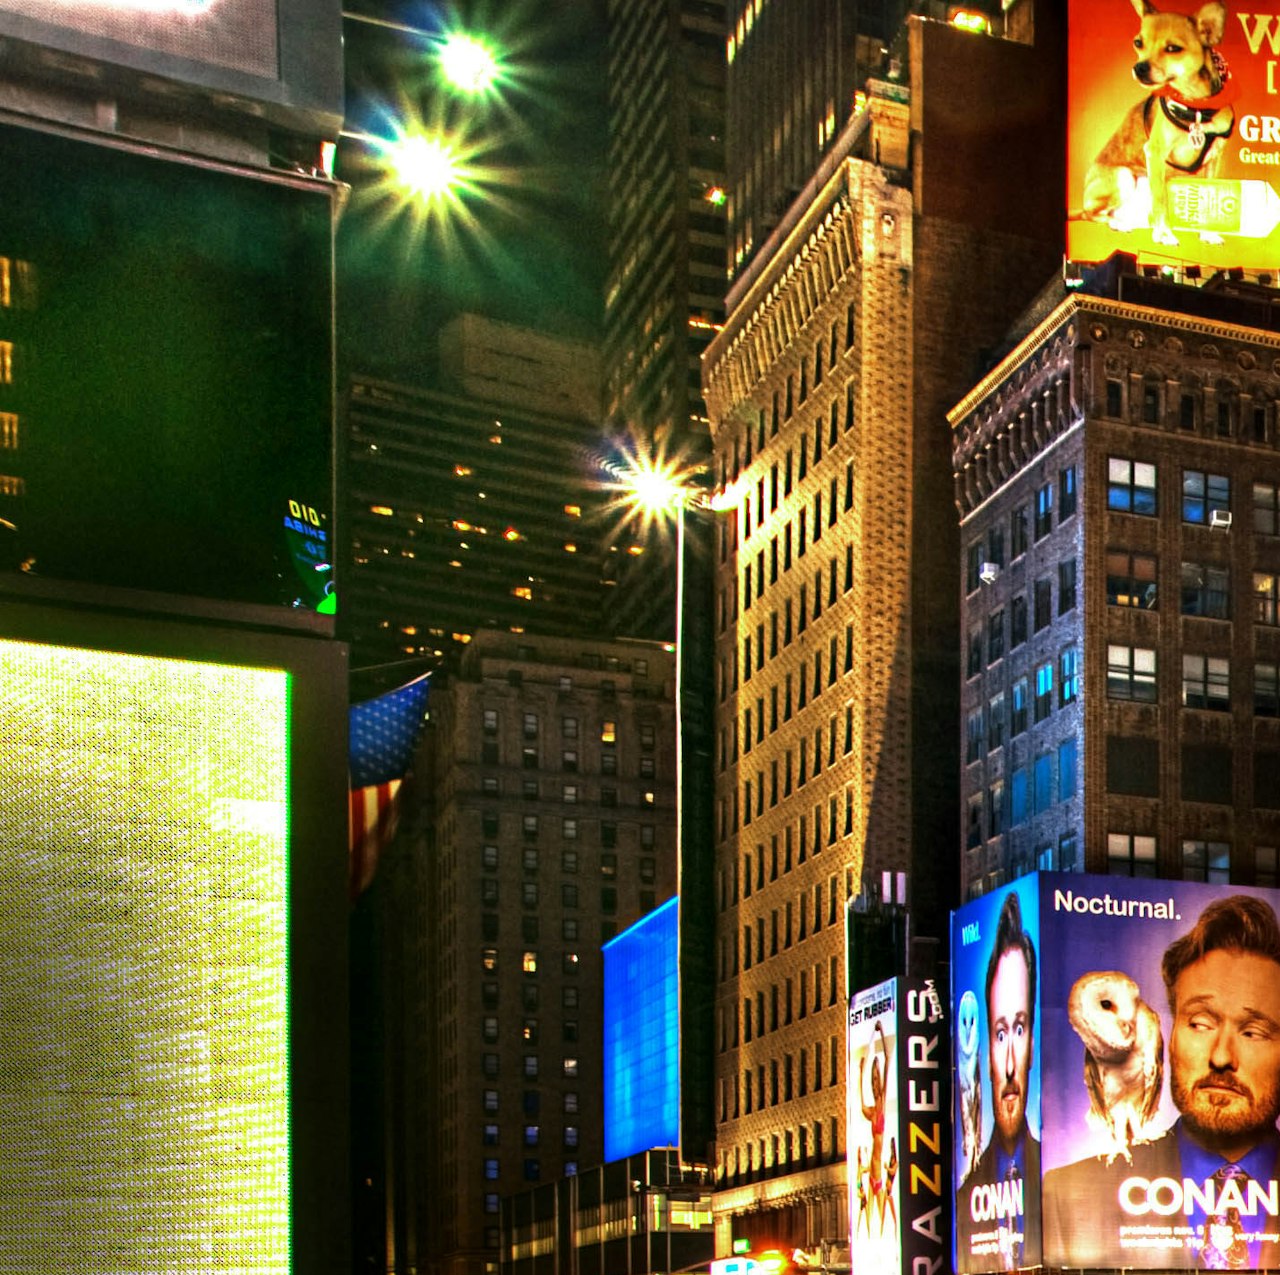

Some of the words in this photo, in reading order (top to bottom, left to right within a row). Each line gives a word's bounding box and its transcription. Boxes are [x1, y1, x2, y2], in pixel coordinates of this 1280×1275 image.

[1239, 148, 1280, 165] Great
[1054, 889, 1182, 921] Nocturnal.
[961, 923, 981, 944] Wild.
[971, 1178, 1024, 1222] CONAN
[1118, 1176, 1279, 1217] CONAN
